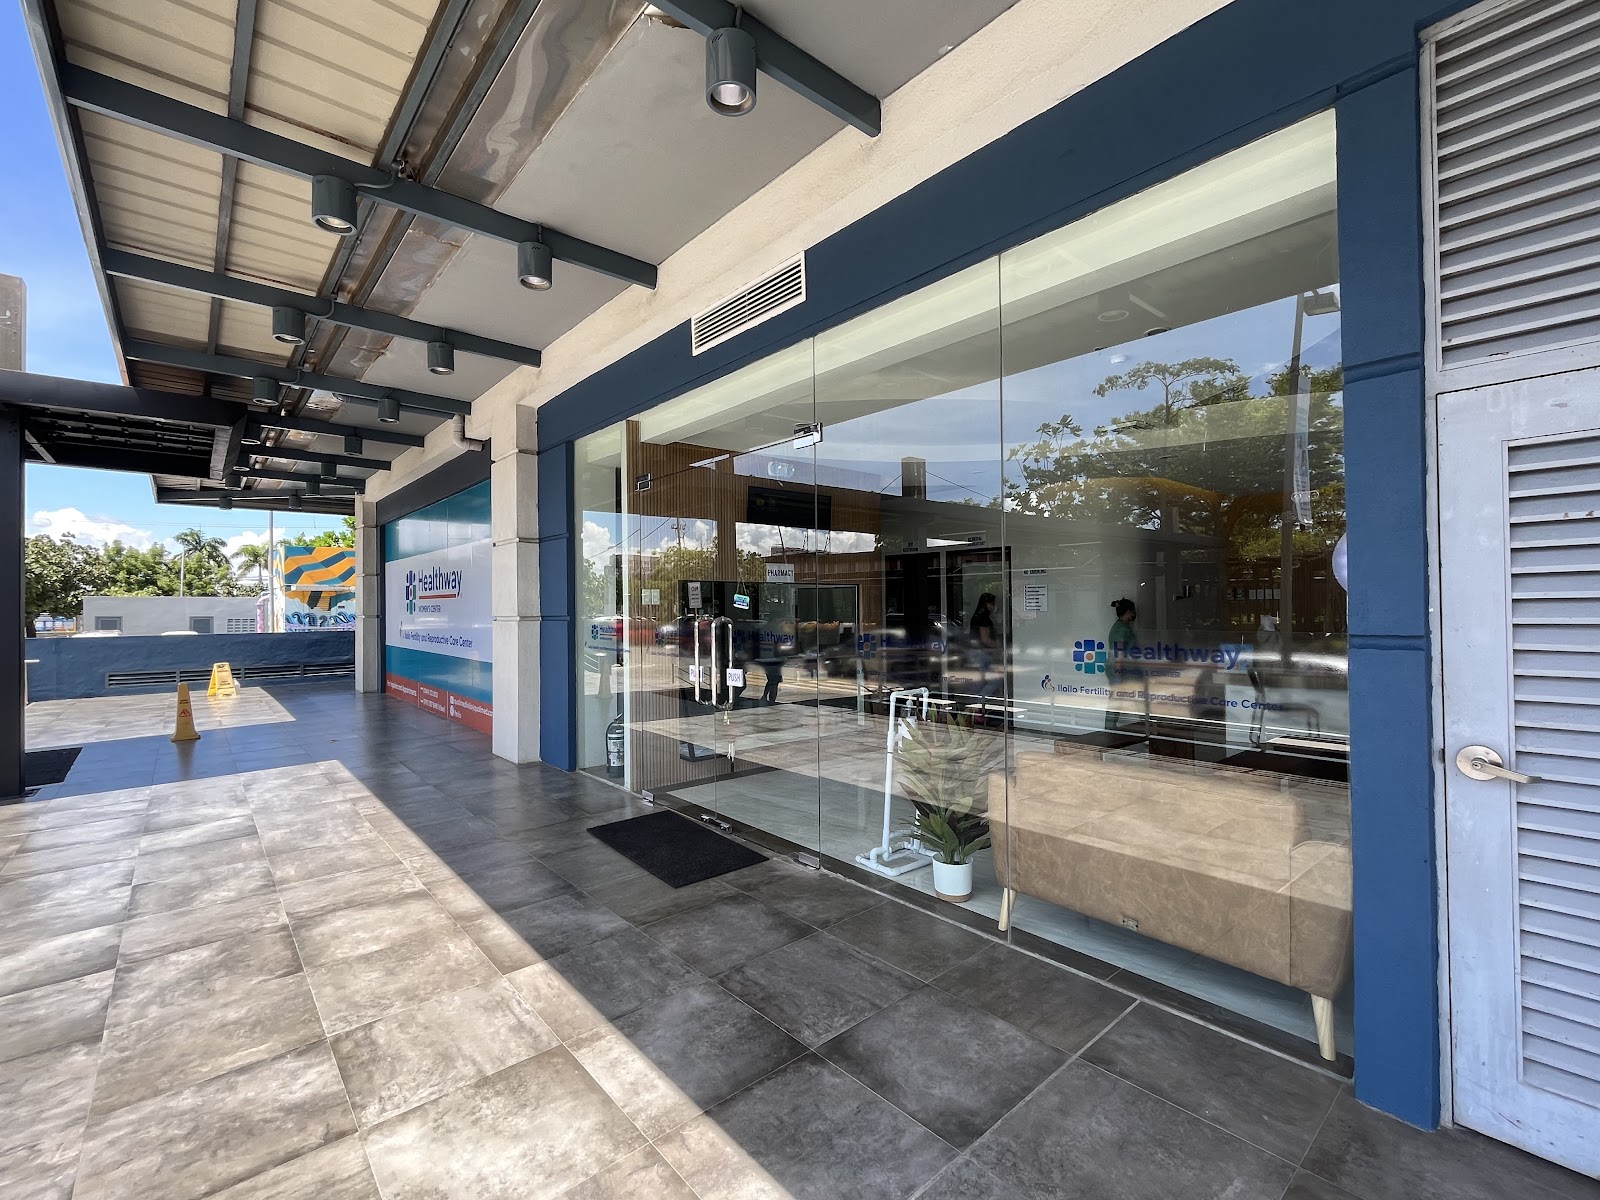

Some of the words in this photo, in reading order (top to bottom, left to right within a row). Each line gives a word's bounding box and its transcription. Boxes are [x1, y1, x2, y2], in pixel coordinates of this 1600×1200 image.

[418, 566, 462, 598] Healthway
[767, 569, 794, 577] PHARMACY
[450, 636, 459, 646] Care
[459, 636, 473, 648] Center
[1113, 641, 1241, 670] Healthway
[728, 672, 741, 682] PUSH
[1057, 684, 1078, 693] Iloilo
[1080, 686, 1114, 698] Fertility
[1116, 690, 1136, 698] and
[1137, 691, 1207, 705] Reproductive
[1210, 696, 1238, 708] Care
[1241, 699, 1284, 711] Center
